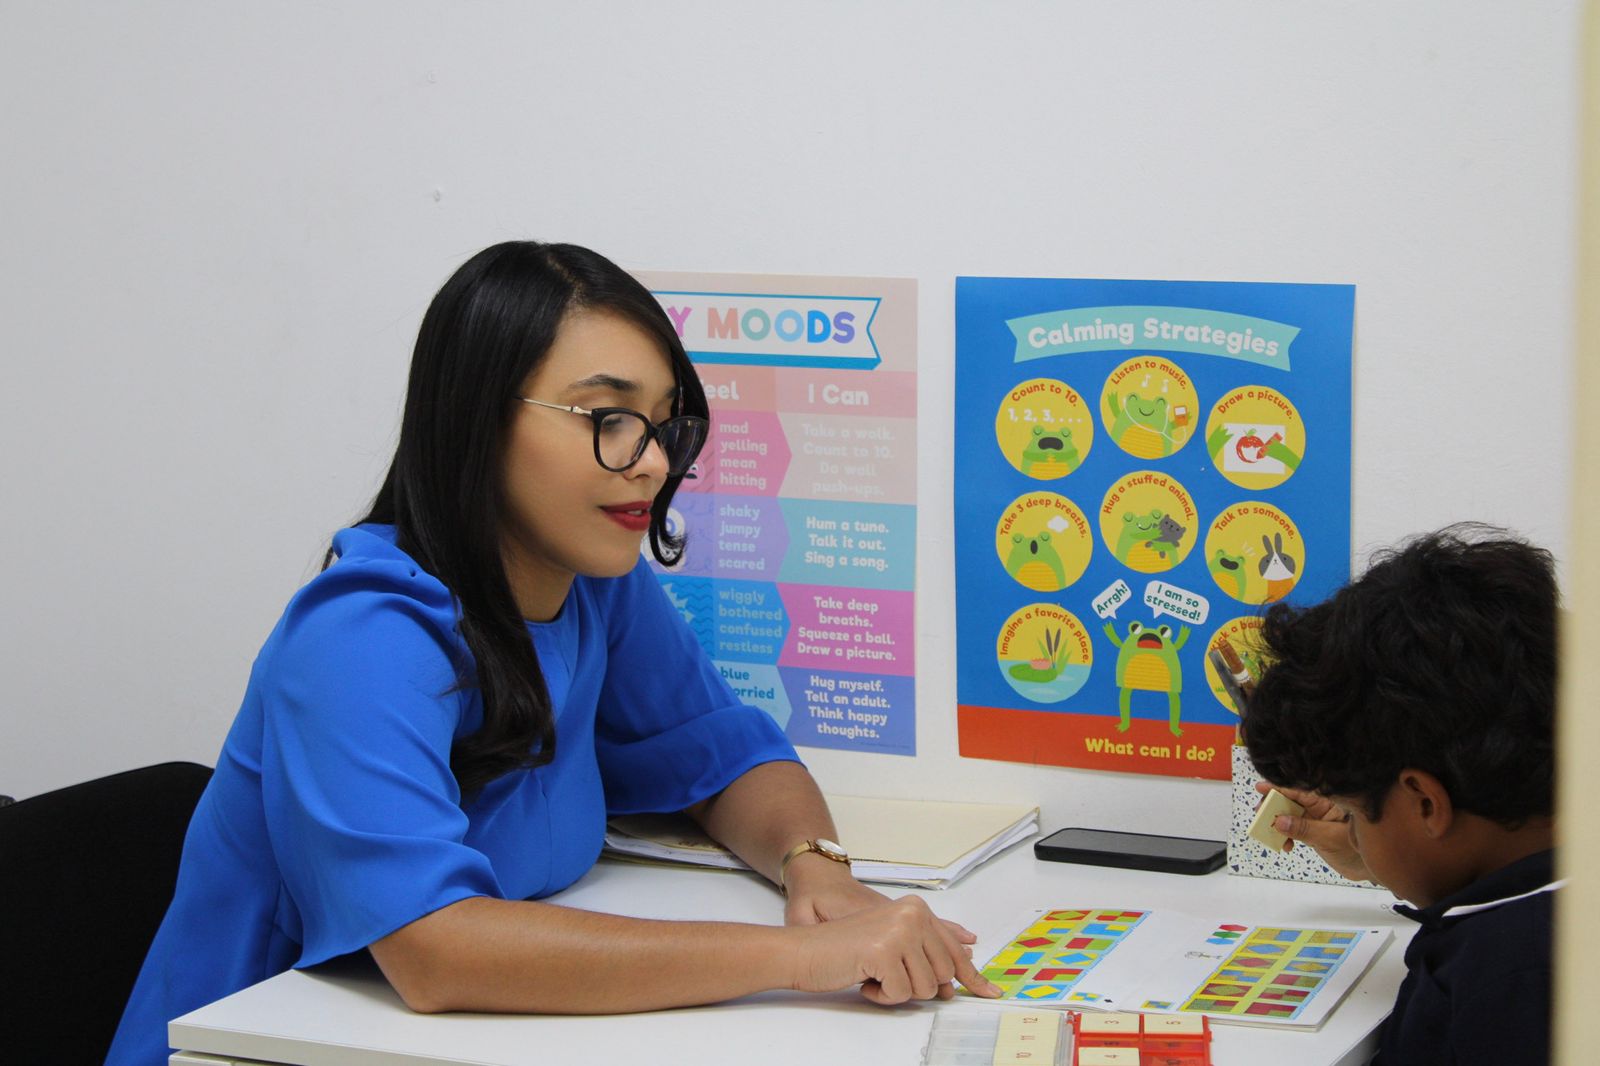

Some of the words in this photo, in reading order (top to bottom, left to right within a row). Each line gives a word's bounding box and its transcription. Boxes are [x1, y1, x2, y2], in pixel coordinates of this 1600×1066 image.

[667, 306, 693, 337] Y
[707, 307, 856, 344] MOODS
[1027, 318, 1135, 349] Calming
[1143, 318, 1280, 357] Strategies
[1111, 360, 1142, 386] Listen
[1145, 360, 1157, 369] to
[1159, 362, 1186, 391] music.
[700, 379, 740, 401] eel
[808, 383, 814, 403] I
[822, 385, 870, 406] Can
[1011, 383, 1046, 403] Count
[1049, 384, 1062, 394] to
[1064, 390, 1078, 408] 10.
[1218, 393, 1244, 414] Draw
[1247, 391, 1255, 399] a
[1257, 390, 1293, 420] picture.
[1007, 408, 1019, 422] 1,
[720, 422, 749, 434] mad
[801, 424, 836, 438] Take
[841, 428, 850, 438] a
[855, 426, 896, 441] walk.
[720, 440, 768, 456] yelling
[803, 441, 847, 455] Count
[854, 444, 869, 457] to
[874, 446, 895, 458] 10.
[720, 457, 757, 470] mean
[820, 463, 840, 475] Do
[846, 465, 877, 477] wall
[720, 472, 767, 490] hitting
[812, 480, 885, 496] push-ups.
[1103, 490, 1119, 514] Hug
[1127, 475, 1167, 488] stuffed
[1168, 485, 1194, 520] animal.
[720, 505, 760, 519] shaky
[1000, 509, 1017, 536] Take
[1017, 501, 1025, 511] 3
[1026, 498, 1052, 508] deep
[1054, 499, 1086, 538] breaths.
[719, 521, 761, 538] jumpy
[806, 517, 837, 531] Hum
[841, 521, 850, 531] a
[854, 519, 889, 533] tune.
[1214, 513, 1236, 532] Talk
[1238, 508, 1250, 518] to
[1253, 507, 1295, 540] someone.
[719, 540, 756, 552] tense
[809, 534, 837, 547] Talk
[842, 535, 853, 549] it
[858, 538, 886, 551] out.
[719, 557, 765, 570] scared
[804, 551, 835, 569] Sing
[839, 556, 848, 566] a
[852, 555, 889, 571] song.
[719, 591, 765, 606] wiggly
[813, 596, 843, 610] Take
[847, 598, 879, 614] deep
[1096, 583, 1128, 614] Arrgh!
[1157, 585, 1162, 594] I
[1165, 589, 1182, 601] am
[1185, 594, 1199, 608] so
[719, 605, 782, 621] bothered
[1146, 594, 1201, 622] stressed!
[818, 612, 873, 627] breaths.
[719, 624, 782, 638] confused
[798, 627, 850, 642] Squeeze
[854, 632, 862, 641] a
[865, 630, 895, 645] ball.
[1000, 615, 1024, 655] Imagine
[1024, 611, 1032, 620] a
[1034, 607, 1077, 632] favorite
[1074, 629, 1090, 663] place.
[719, 641, 773, 654] restless
[797, 642, 830, 655] Draw
[835, 646, 843, 656] a
[846, 646, 896, 661] picture.
[720, 667, 750, 680] blue
[733, 686, 775, 699] orried
[810, 676, 835, 690] Hug
[838, 679, 884, 693] myself.
[804, 690, 829, 703] Tell
[833, 694, 849, 705] an
[852, 695, 890, 708] adult.
[808, 706, 844, 720] Think
[848, 709, 888, 726] happy
[817, 722, 880, 739] thoughts.
[1085, 738, 1133, 756] What
[1139, 745, 1170, 758] can
[1176, 745, 1181, 759] I
[1186, 746, 1216, 762] do?
